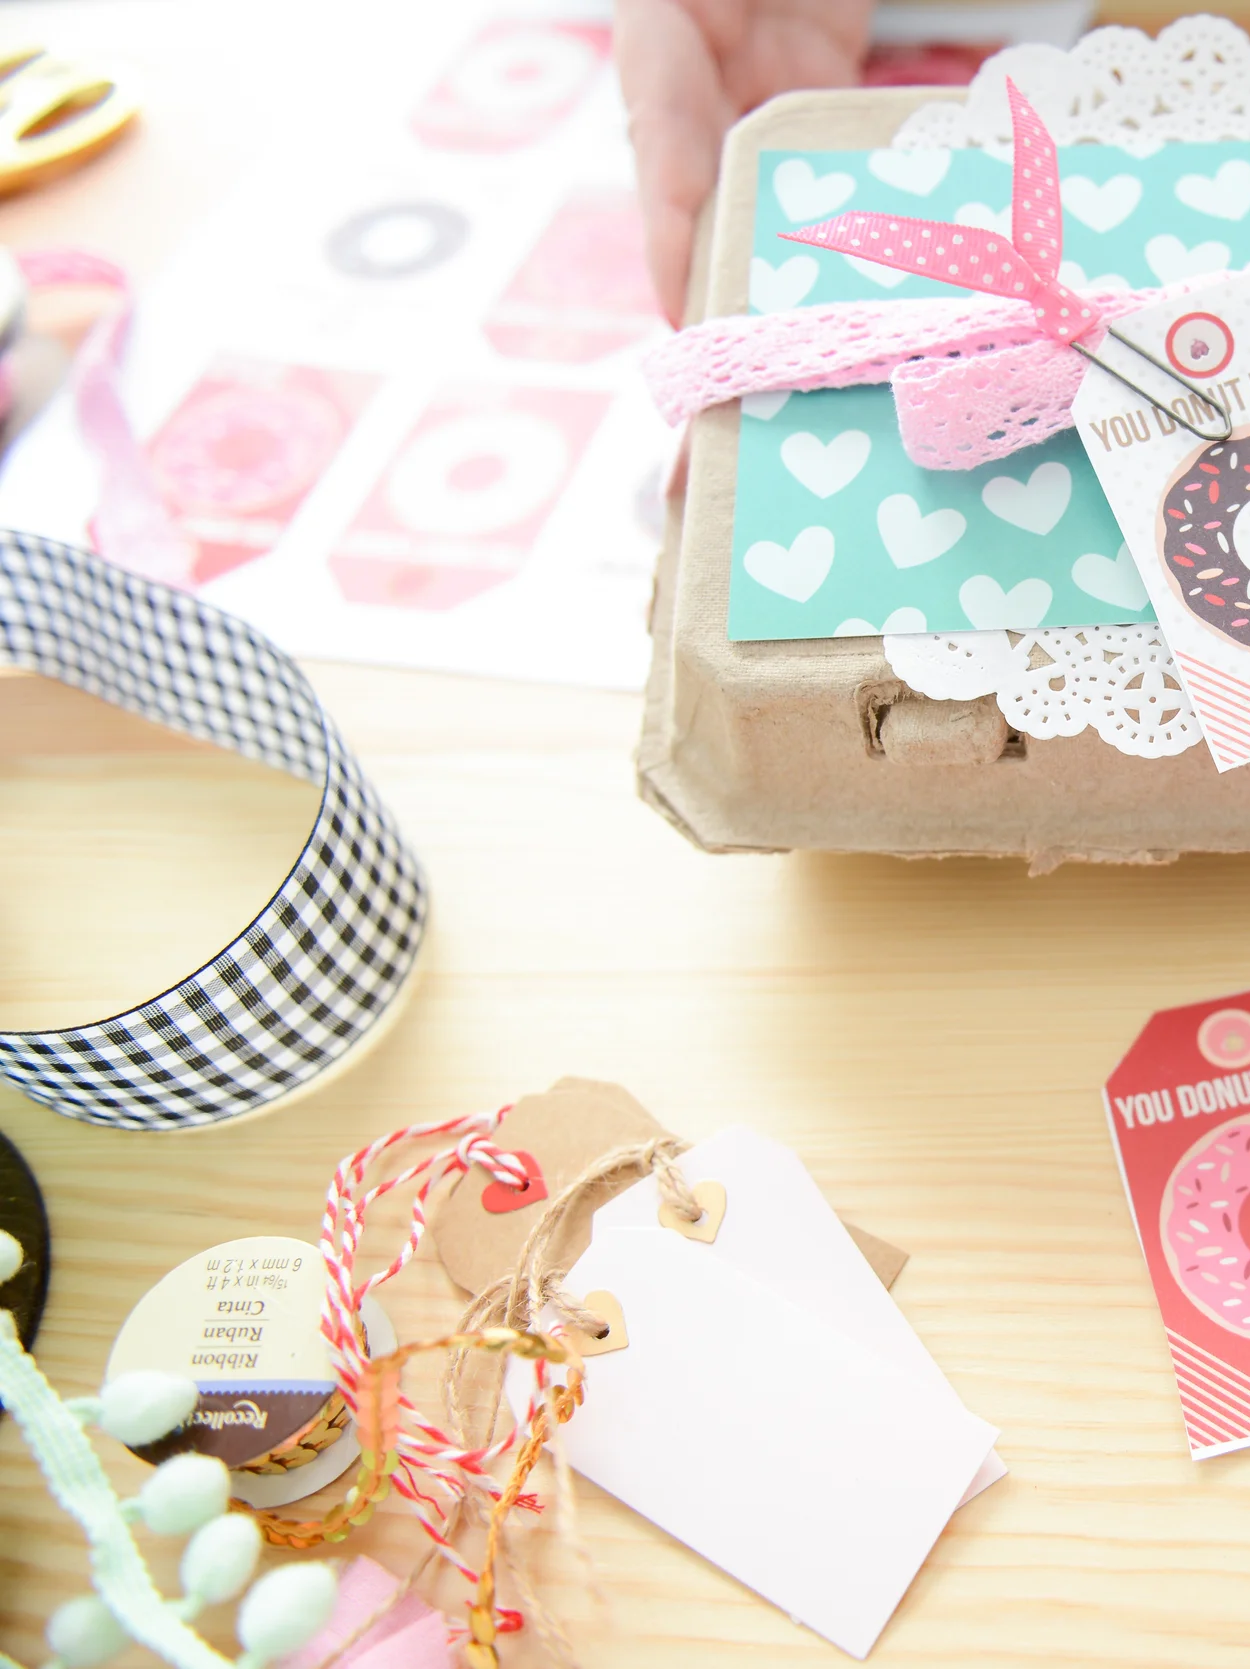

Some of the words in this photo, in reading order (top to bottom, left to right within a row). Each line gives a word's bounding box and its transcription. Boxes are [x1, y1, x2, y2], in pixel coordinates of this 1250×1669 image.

[1089, 410, 1151, 452] YOU
[1152, 377, 1247, 437] DONUT
[1114, 1089, 1174, 1129] YOU
[206, 1259, 221, 1272] m
[223, 1259, 244, 1274] 1.2
[248, 1259, 260, 1271] x
[261, 1258, 290, 1271] mm
[292, 1257, 303, 1273] 6
[206, 1275, 219, 1291] ft
[221, 1275, 231, 1290] 4
[233, 1275, 244, 1288] x
[246, 1275, 260, 1290] in
[217, 1300, 265, 1316] Cinta
[203, 1327, 263, 1343] Ruban
[191, 1353, 259, 1370] Ribbon
[180, 1399, 268, 1430] Recollect
